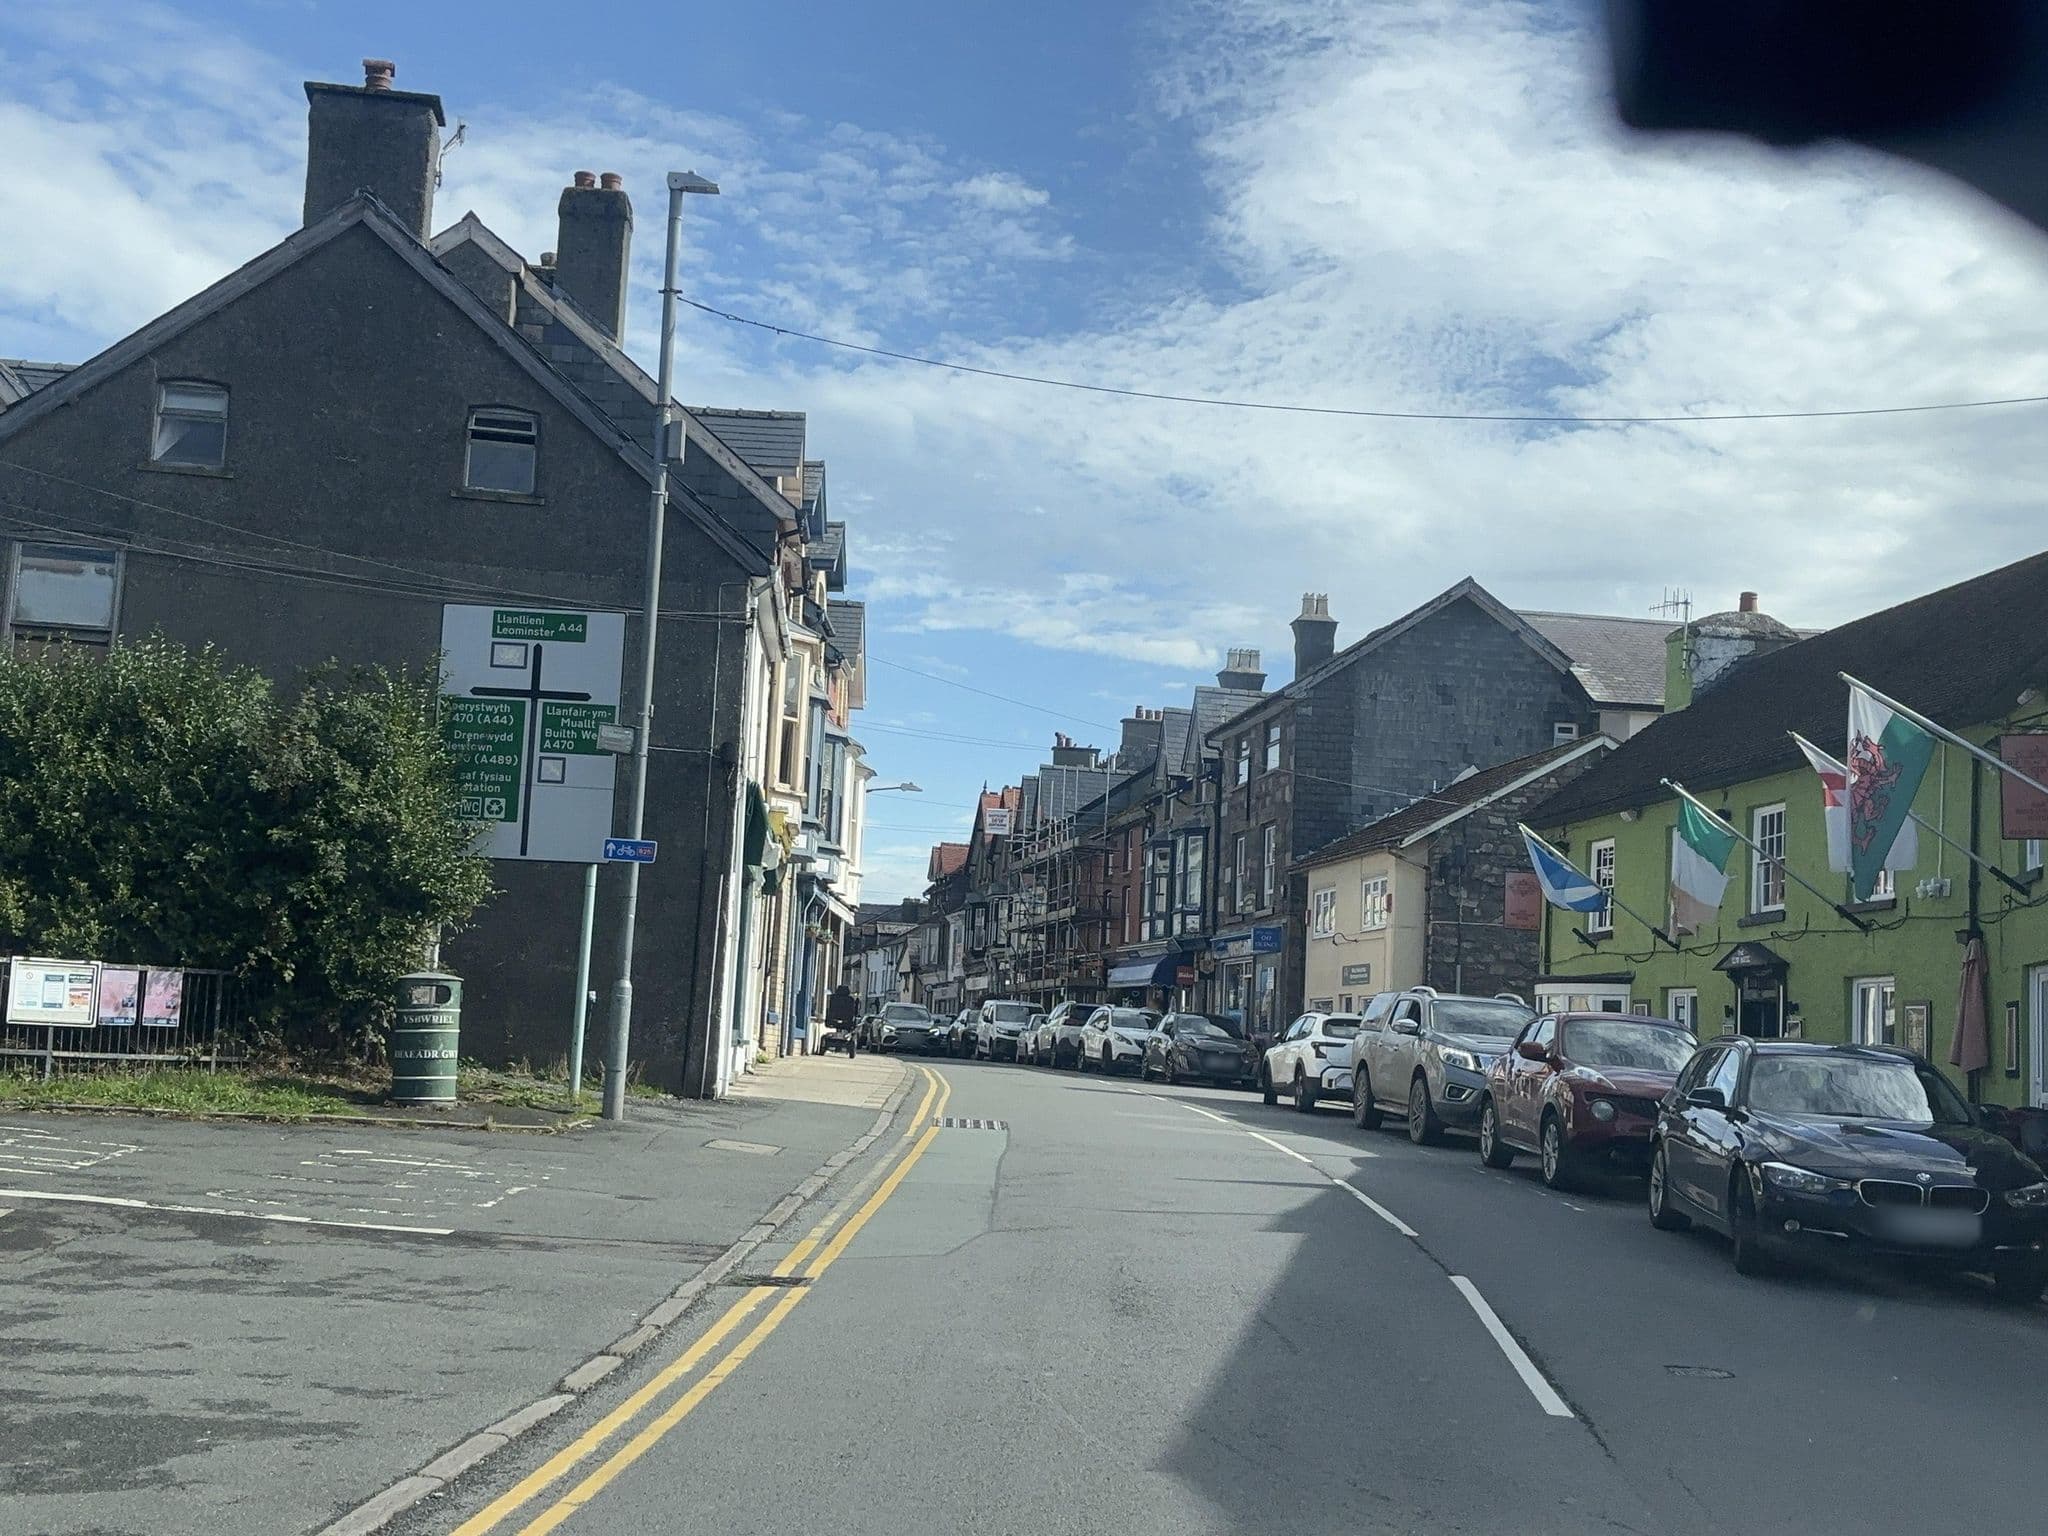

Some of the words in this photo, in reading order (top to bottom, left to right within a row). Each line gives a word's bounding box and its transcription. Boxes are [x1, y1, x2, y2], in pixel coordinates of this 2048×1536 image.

[497, 614, 545, 625] Llanllieni
[496, 625, 555, 637] Leominster
[558, 622, 583, 633] A44
[477, 713, 514, 726] (A44)
[560, 717, 596, 729] Muallt
[544, 728, 577, 739] Builth
[543, 739, 575, 750] A470
